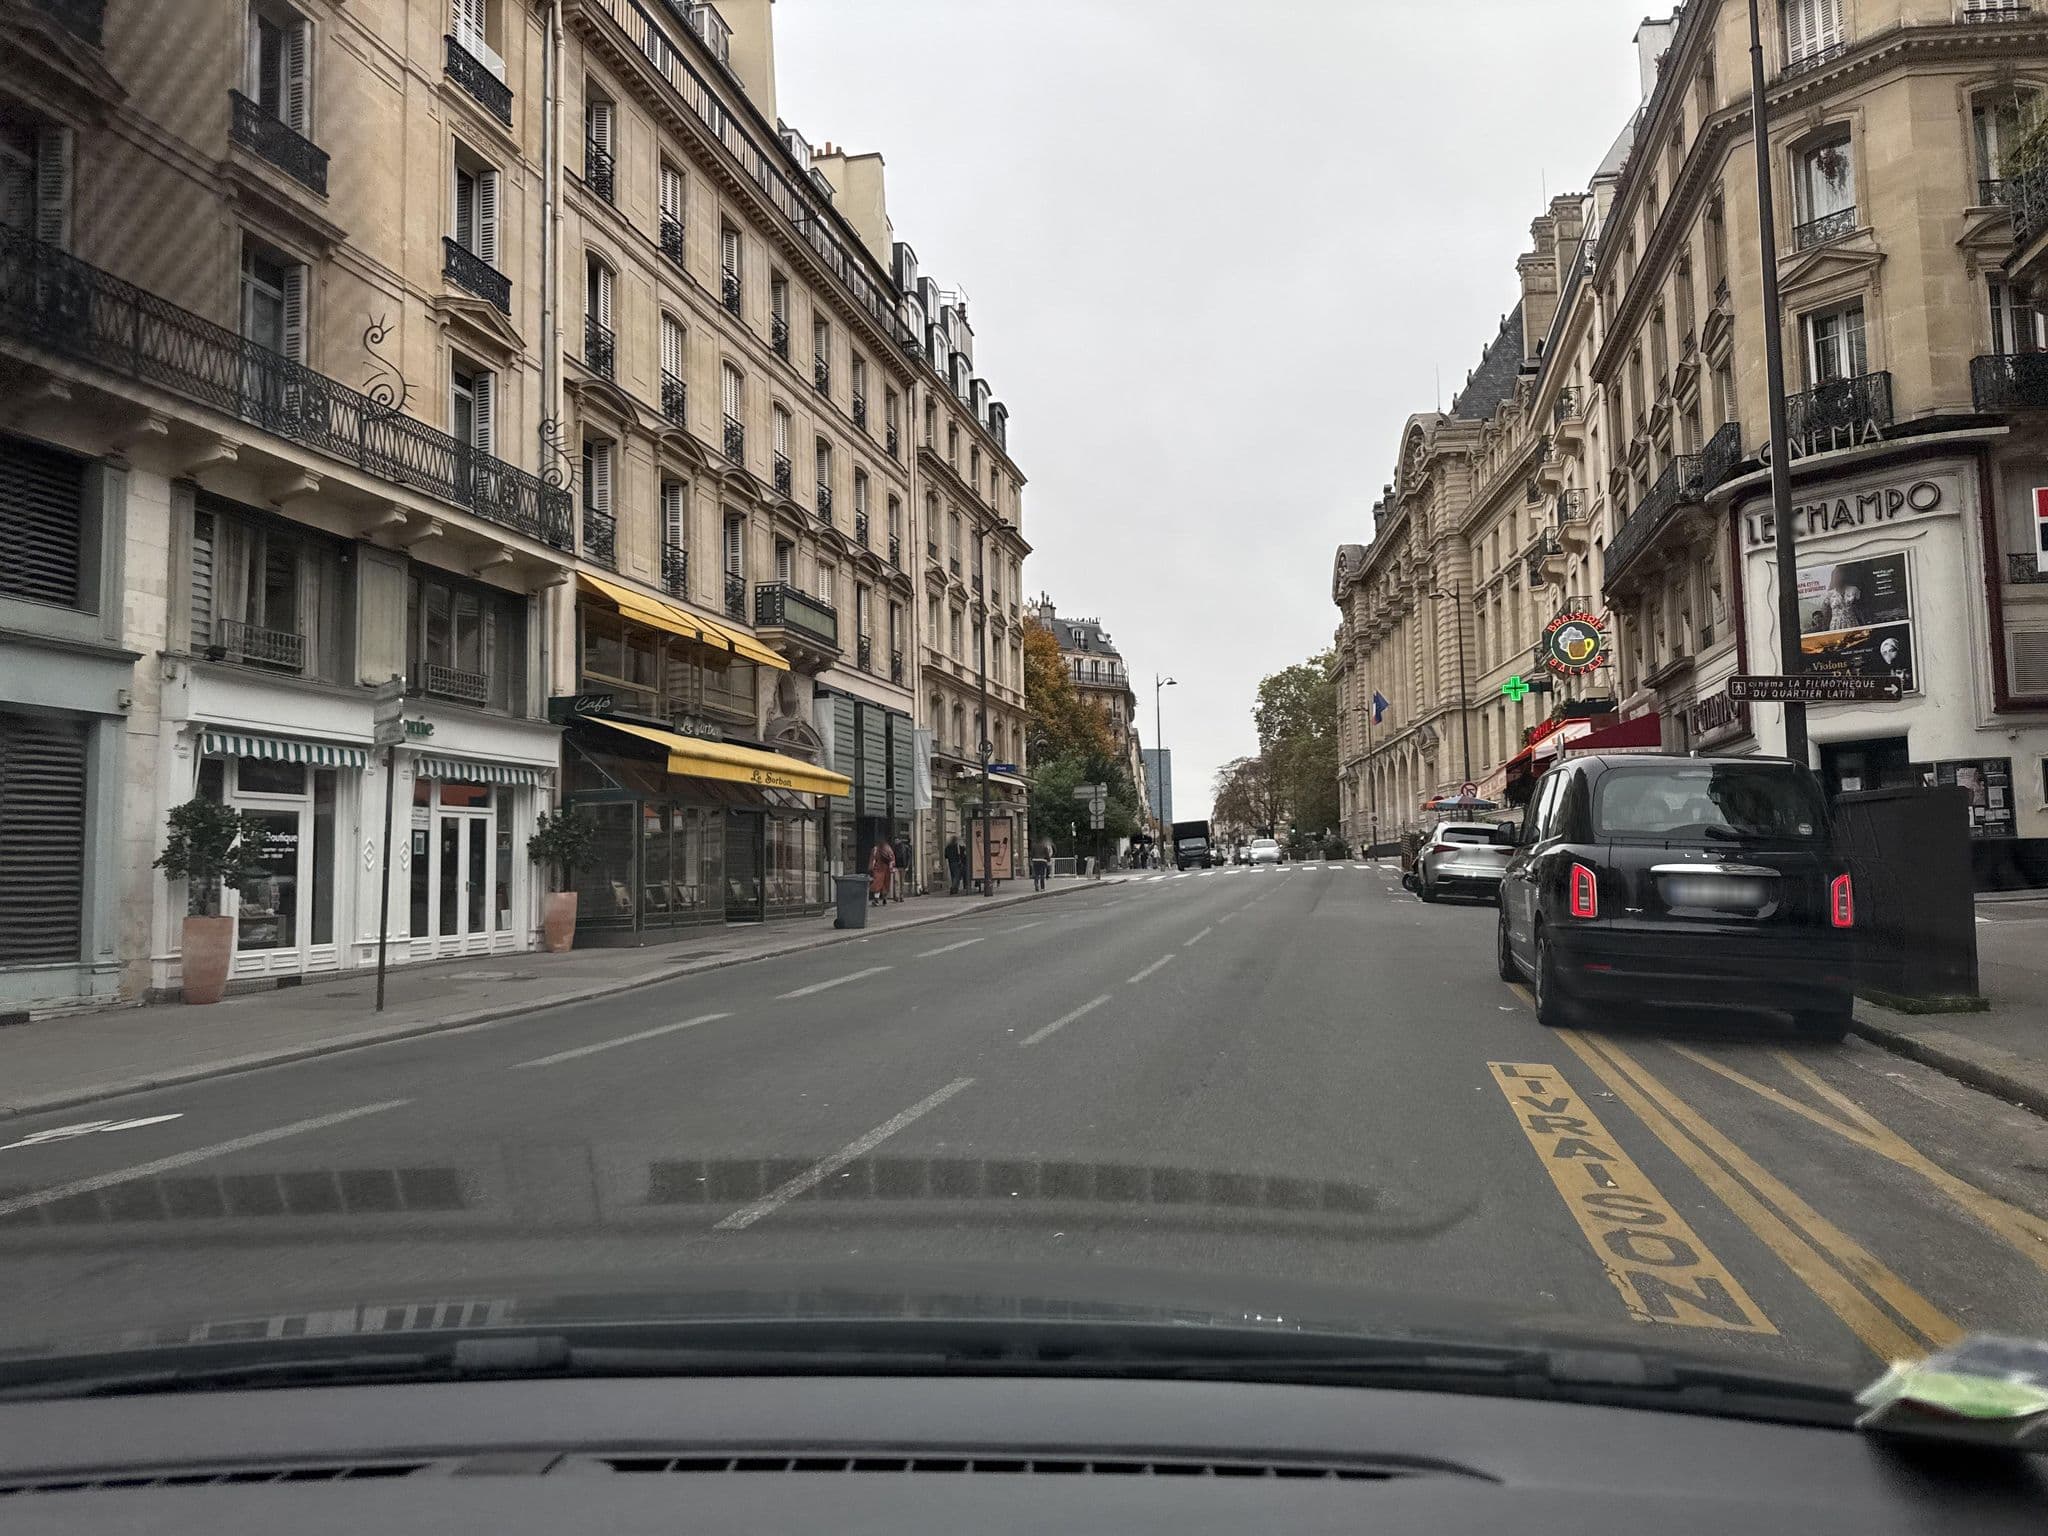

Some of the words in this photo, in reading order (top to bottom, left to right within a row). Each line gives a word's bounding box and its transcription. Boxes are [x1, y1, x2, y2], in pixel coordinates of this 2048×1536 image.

[1758, 418, 1884, 467] CNEMA
[1547, 612, 1605, 632] BRASSERIE
[1548, 655, 1605, 675] BALZAR
[1813, 660, 1848, 671] Violons
[1753, 689, 1768, 698] DU
[1772, 689, 1823, 698] QUARTIER
[1827, 689, 1856, 698] LATIN
[1789, 680, 1800, 688] LA
[574, 696, 611, 713] Café
[750, 768, 763, 784] Le
[764, 770, 792, 788] Sorbon
[1497, 1062, 1755, 1328] LIVRAISON
